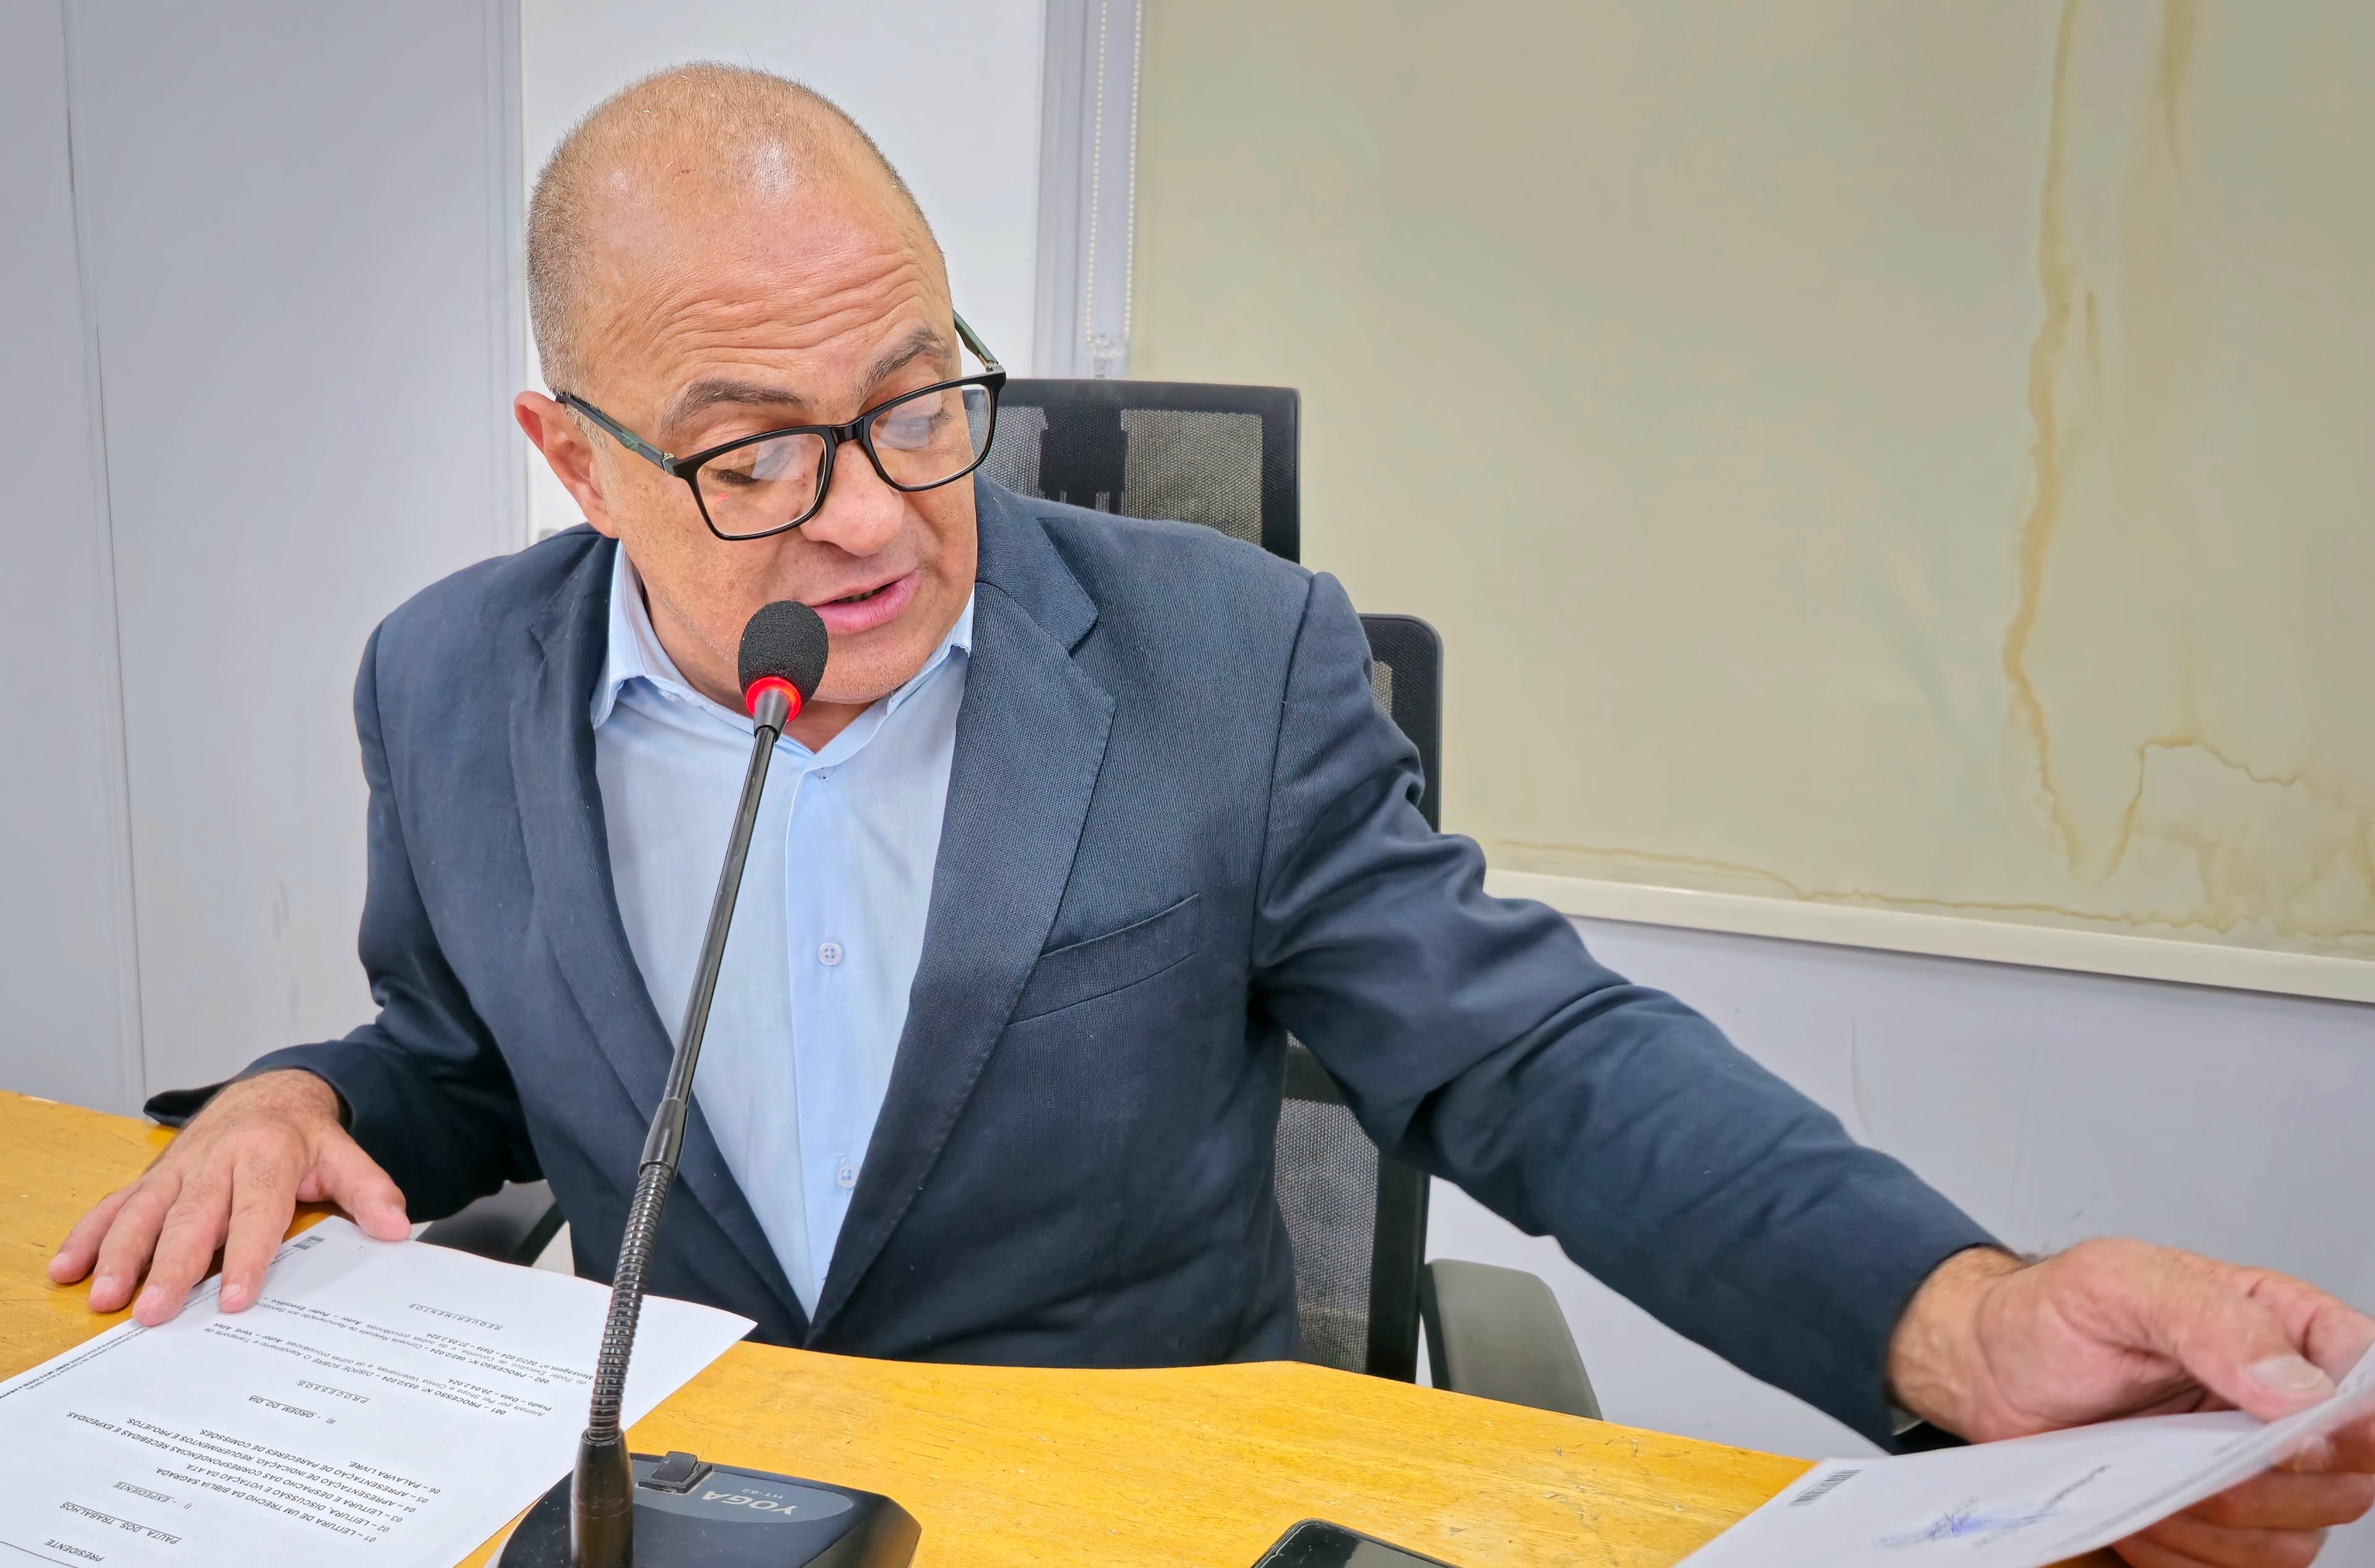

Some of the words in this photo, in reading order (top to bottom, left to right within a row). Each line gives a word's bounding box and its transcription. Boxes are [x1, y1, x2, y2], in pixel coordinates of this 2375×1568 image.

[271, 1299, 306, 1311] Executivo
[340, 1317, 362, 1325] Autor
[426, 1332, 469, 1347] 27.05.2.024.
[429, 1348, 466, 1361] 062/2.024
[476, 1346, 494, 1354] Data
[311, 1357, 341, 1368] SOBRE
[500, 1353, 537, 1366] 027/2.024
[480, 1362, 527, 1377] PROCESSO
[511, 1363, 547, 1376] Executivo
[550, 1366, 594, 1380] Mensagem
[382, 1376, 419, 1389] 053/2.024
[549, 1373, 573, 1382] Poder
[448, 1378, 493, 1394] 29.04.2.024.
[248, 1395, 265, 1403] DIA
[434, 1390, 482, 1408] PROCESSO
[456, 1389, 481, 1399] Shops
[500, 1394, 519, 1402] Data
[265, 1400, 282, 1408] DO
[281, 1405, 314, 1418] ORDEM
[513, 1405, 545, 1416] Animais
[528, 1402, 552, 1411] Prado
[67, 1412, 114, 1430] EXPEDIDAS.
[127, 1418, 173, 1436] PROJETOS.
[121, 1430, 171, 1449] RECEBIDAS
[199, 1429, 251, 1447] COMISSÕES.
[179, 1436, 255, 1461] REQUERIMENTOS
[169, 1446, 262, 1476] CORRESPONDÊNCIAS
[265, 1449, 320, 1468] PARECERES
[187, 1463, 207, 1472] ATA.
[256, 1457, 307, 1476] INDICAÇÃO,
[348, 1461, 377, 1474] LIVRE.
[156, 1467, 200, 1484] SAGRADA.
[219, 1473, 263, 1490] VOTAÇÃO
[262, 1473, 283, 1482] DAS
[378, 1471, 421, 1488] PALAVRA
[200, 1481, 231, 1493] BÍBLIA
[283, 1479, 334, 1499] DESPACHO
[333, 1470, 409, 1497] APRESENTAÇÃO
[113, 1482, 170, 1502] EXPEDIENTE
[272, 1489, 327, 1510] DISCUSSÃO
[320, 1478, 396, 1506] APRESENTAÇÃO
[245, 1494, 283, 1510] TRECHO
[343, 1499, 383, 1516] LEITURA
[703, 1491, 798, 1515] YOGA
[59, 1503, 115, 1524] TRABALHOS
[283, 1507, 300, 1516] UM
[299, 1513, 315, 1521] DE
[329, 1507, 370, 1526] LEITURA,
[119, 1522, 142, 1532] DOS
[315, 1518, 356, 1535] LEITURA
[147, 1530, 179, 1544] PAUTA
[45, 1539, 105, 1562] PRESIDENTE
